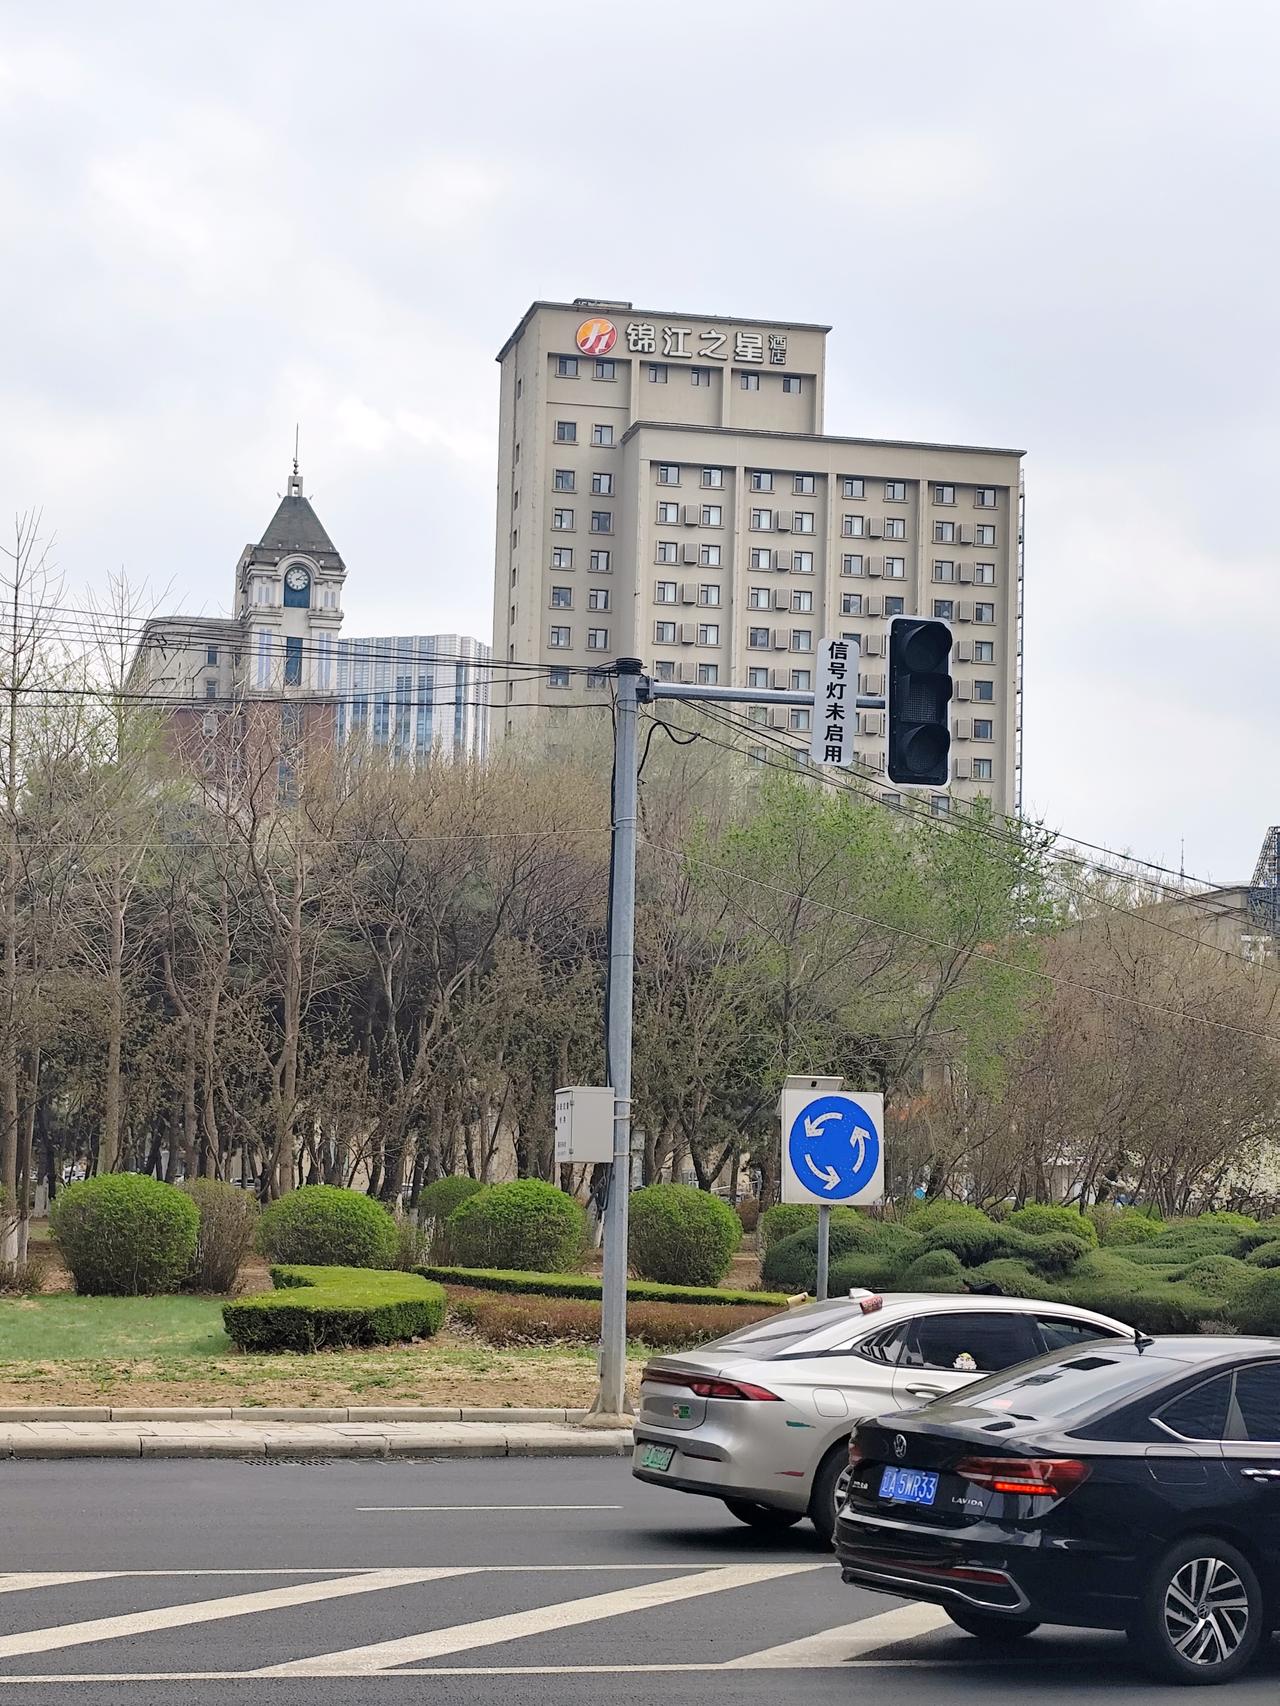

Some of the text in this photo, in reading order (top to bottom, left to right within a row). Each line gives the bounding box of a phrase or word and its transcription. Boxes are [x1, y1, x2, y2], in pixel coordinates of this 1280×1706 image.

[626, 321, 764, 363] 锦江之星
[769, 334, 787, 365] 酒店
[823, 641, 849, 763] 信号灯未启用
[951, 1496, 983, 1508] LAVIDA
